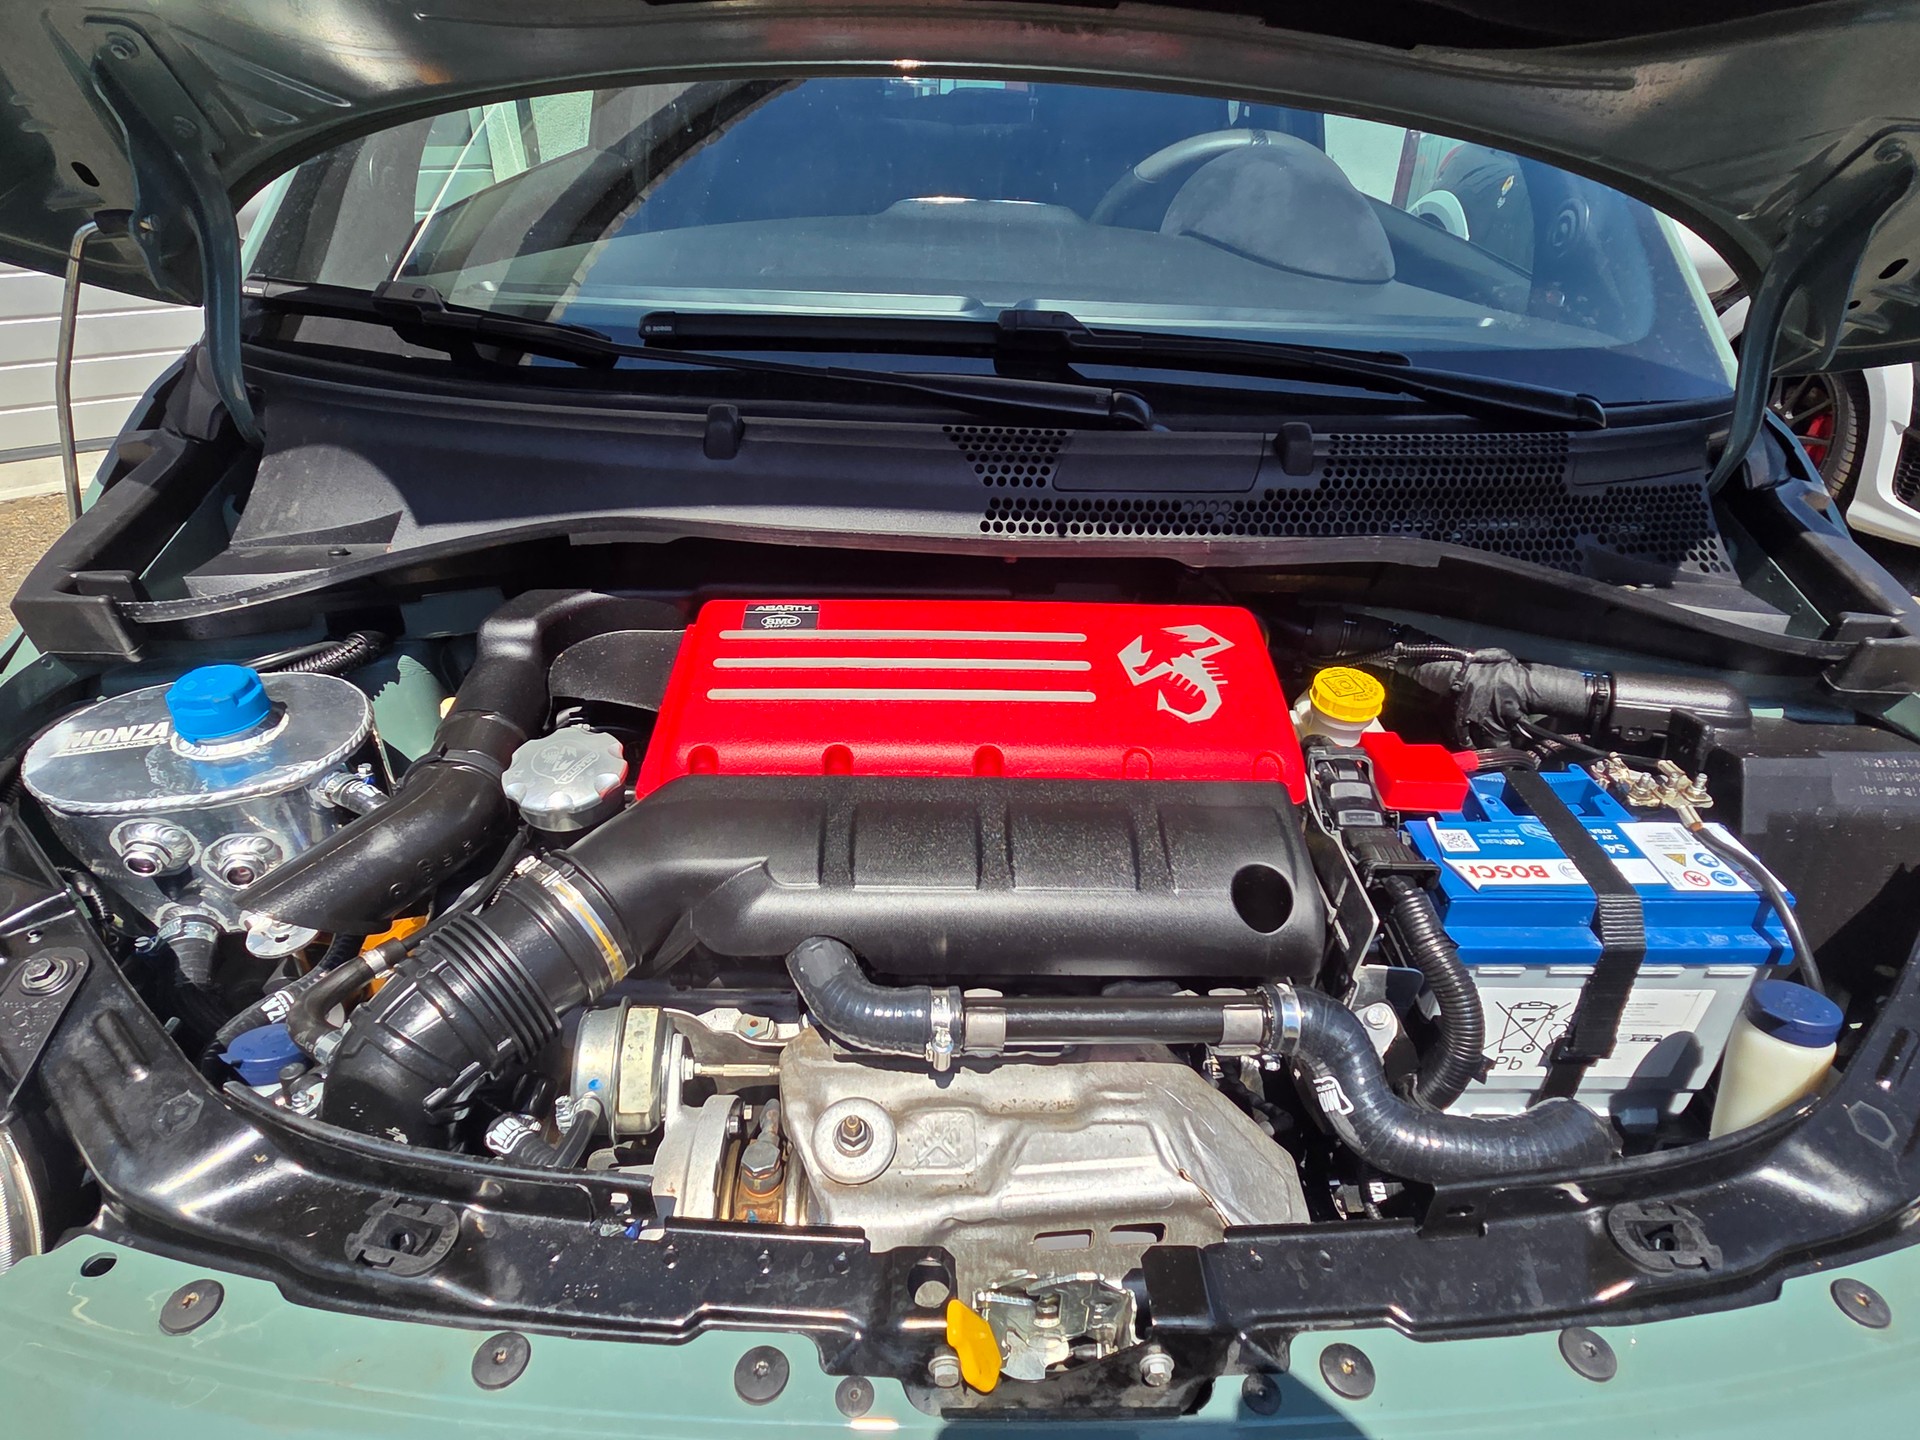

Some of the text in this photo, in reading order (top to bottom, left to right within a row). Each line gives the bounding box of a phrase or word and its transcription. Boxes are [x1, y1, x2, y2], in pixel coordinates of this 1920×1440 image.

[754, 604, 813, 612] ABARTH
[64, 721, 170, 749] MONZA
[1603, 843, 1630, 855] S4
[1495, 1056, 1523, 1071] Pb
